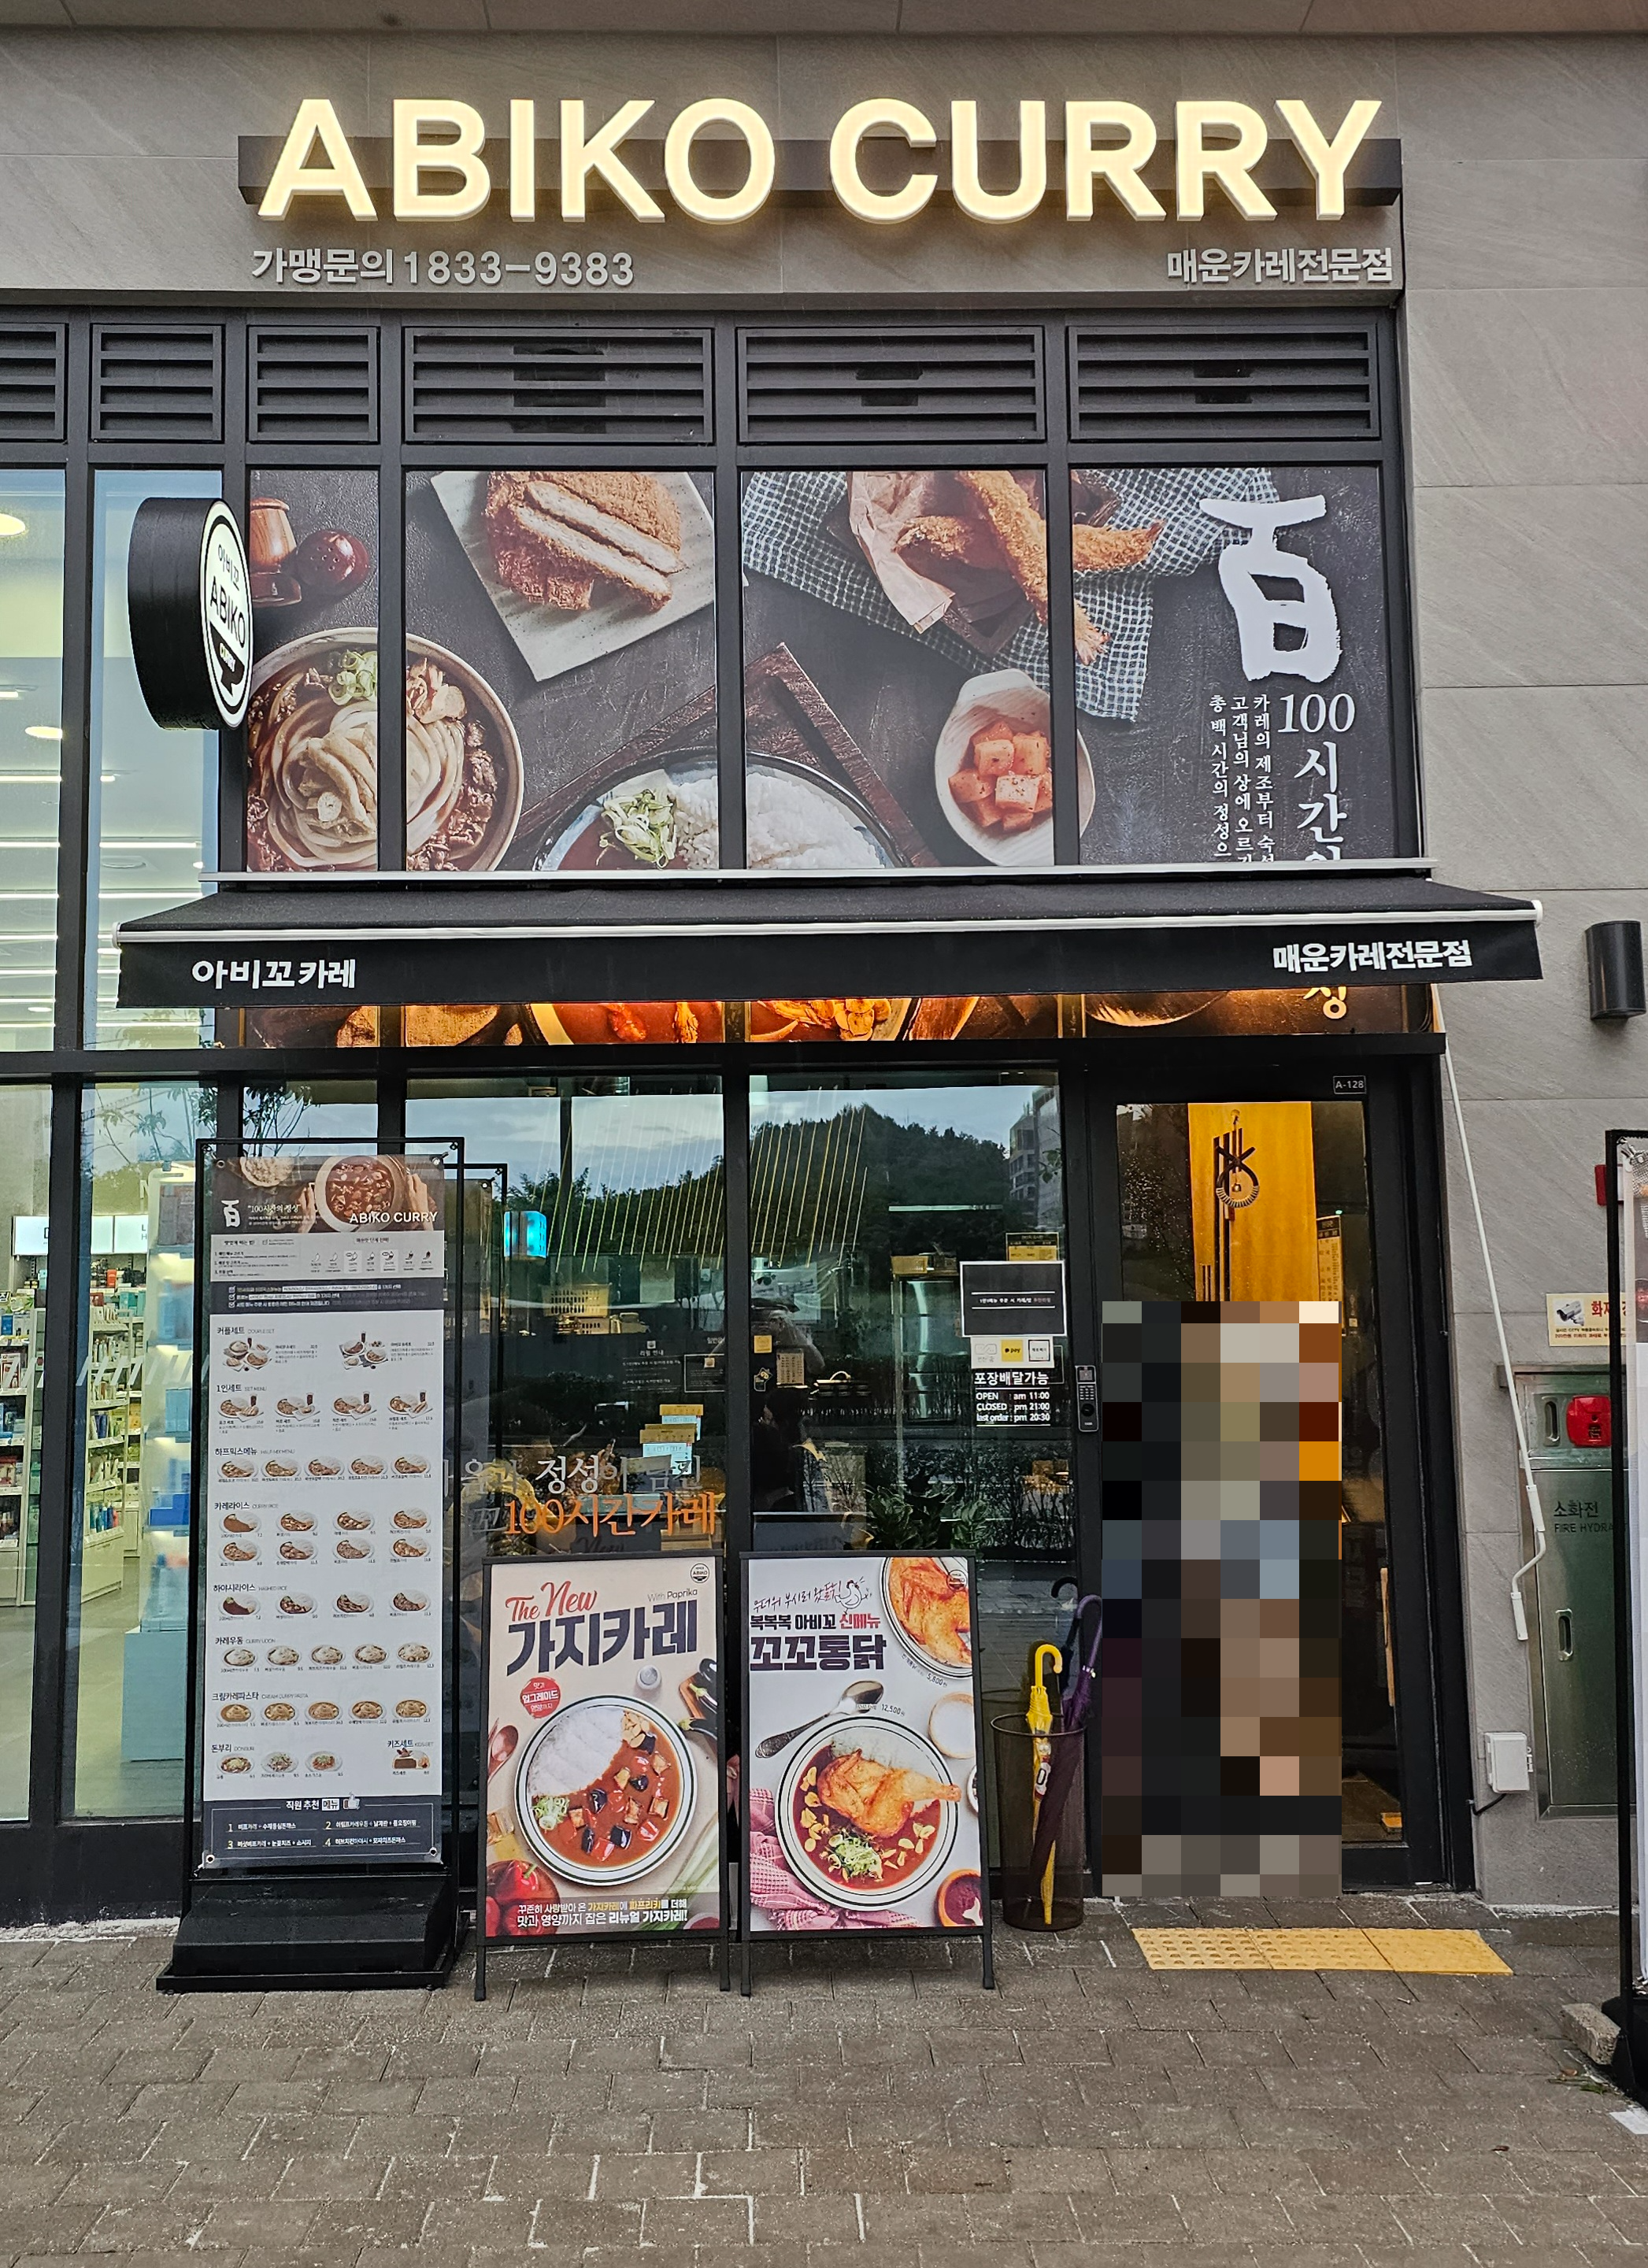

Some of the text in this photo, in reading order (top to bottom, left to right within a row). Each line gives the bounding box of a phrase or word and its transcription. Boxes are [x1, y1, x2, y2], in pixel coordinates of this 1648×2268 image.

[257, 97, 1383, 224] ABIKO CURRY
[252, 248, 634, 286] 가맹문의 1833-9383
[1167, 248, 1393, 284] 매운카레전문점
[217, 543, 239, 591] 아비꼬
[209, 575, 246, 649] ABIKO
[1254, 694, 1270, 749] 카레의
[1277, 693, 1355, 733] 100
[1231, 696, 1249, 768] 고객님의
[1209, 694, 1231, 857] 총 백 시간의 정성으
[1255, 754, 1273, 829] 제조부터
[1233, 774, 1251, 811] 상에
[1272, 940, 1472, 973] 매운카레전문점
[191, 959, 356, 990] 아비꼬카레
[1335, 1080, 1364, 1089] A-128
[349, 1211, 438, 1223] ABIKO CURRY
[974, 1371, 1049, 1386] 포장배달가능
[976, 1392, 998, 1400] OPEN
[1013, 1404, 1028, 1414] pm
[1029, 1402, 1050, 1411] 21:00
[1013, 1415, 1028, 1423] pm
[1029, 1412, 1050, 1421] 20:30
[504, 1491, 716, 1537] 100시간카레
[1553, 1499, 1599, 1519] 소화전
[1554, 1523, 1577, 1534] FIRE
[505, 1580, 598, 1622] The New
[667, 1588, 698, 1600] Paprika
[750, 1613, 881, 1630] 복복복 아비꼬 신메뉴
[506, 1600, 698, 1677] 가지카레
[750, 1634, 887, 1671] 꼬꼬통닭
[522, 1689, 559, 1704] 업그레이드
[286, 1800, 339, 1811] 직원 추천 메뉴
[517, 1909, 688, 1928] 맛과 영양까지 잡은 리뉴얼 가지카레!
[518, 1902, 543, 1915] 꾸준히
[543, 1902, 576, 1914] 사랑받아
[587, 1900, 628, 1911] 가지카레에
[670, 1898, 687, 1909] 더해
